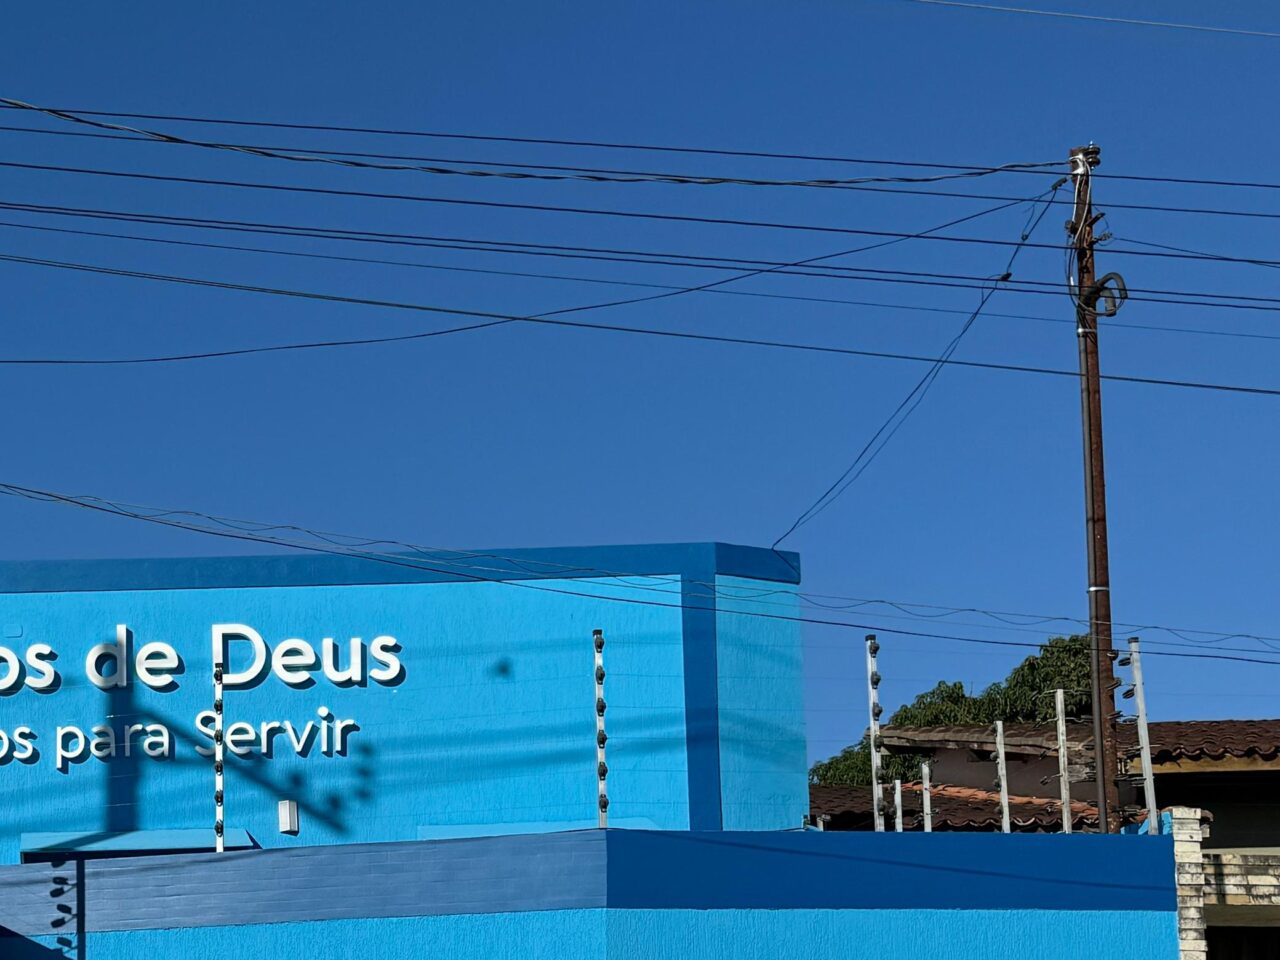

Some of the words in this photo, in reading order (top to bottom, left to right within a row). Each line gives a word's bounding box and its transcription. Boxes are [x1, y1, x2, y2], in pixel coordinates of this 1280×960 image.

[86, 624, 179, 689] de
[212, 623, 401, 684] Deus
[56, 723, 170, 769] para
[195, 706, 355, 756] Servir
